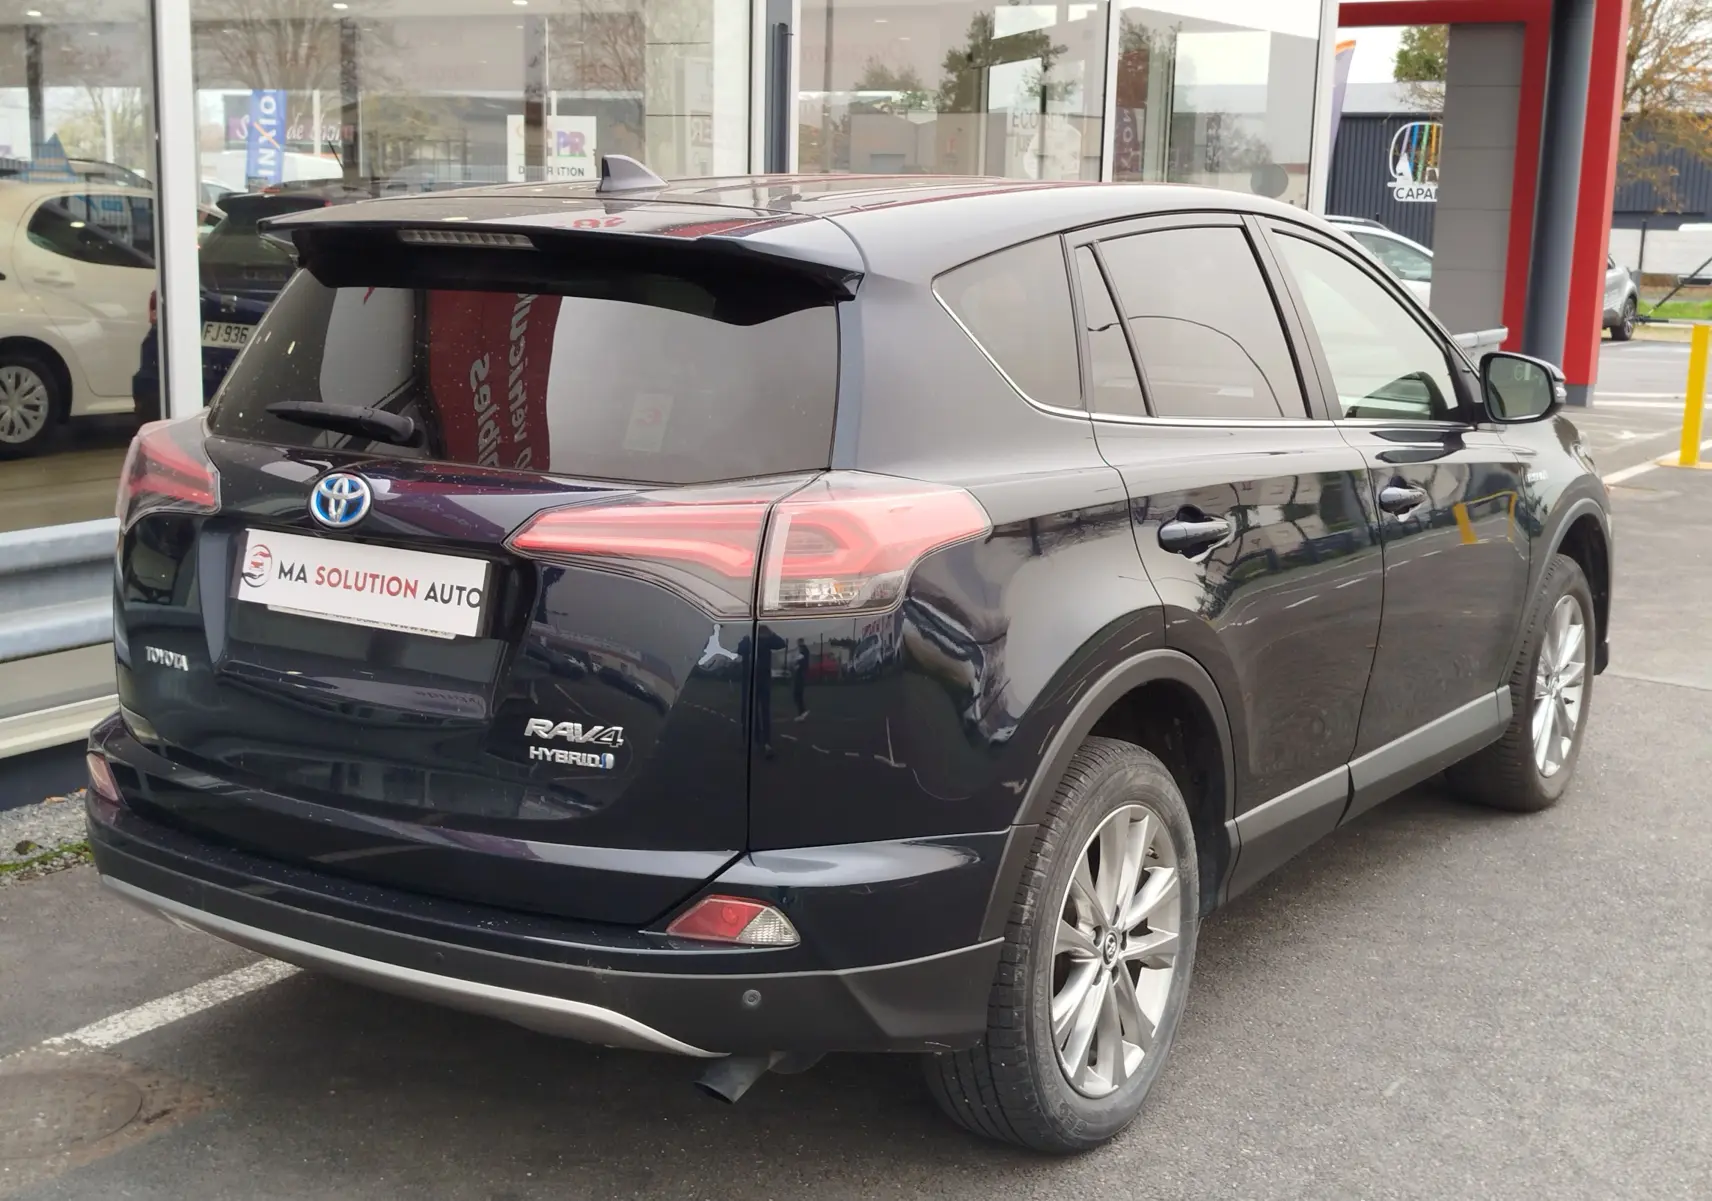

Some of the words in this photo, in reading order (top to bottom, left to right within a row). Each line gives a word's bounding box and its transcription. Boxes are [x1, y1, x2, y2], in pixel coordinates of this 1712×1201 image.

[278, 560, 308, 584] MA
[315, 565, 419, 600] SOLUTION
[424, 581, 482, 609] AUTO
[145, 645, 189, 671] TOYOTA
[523, 717, 624, 748] RAV4
[529, 746, 602, 768] HYBRID
